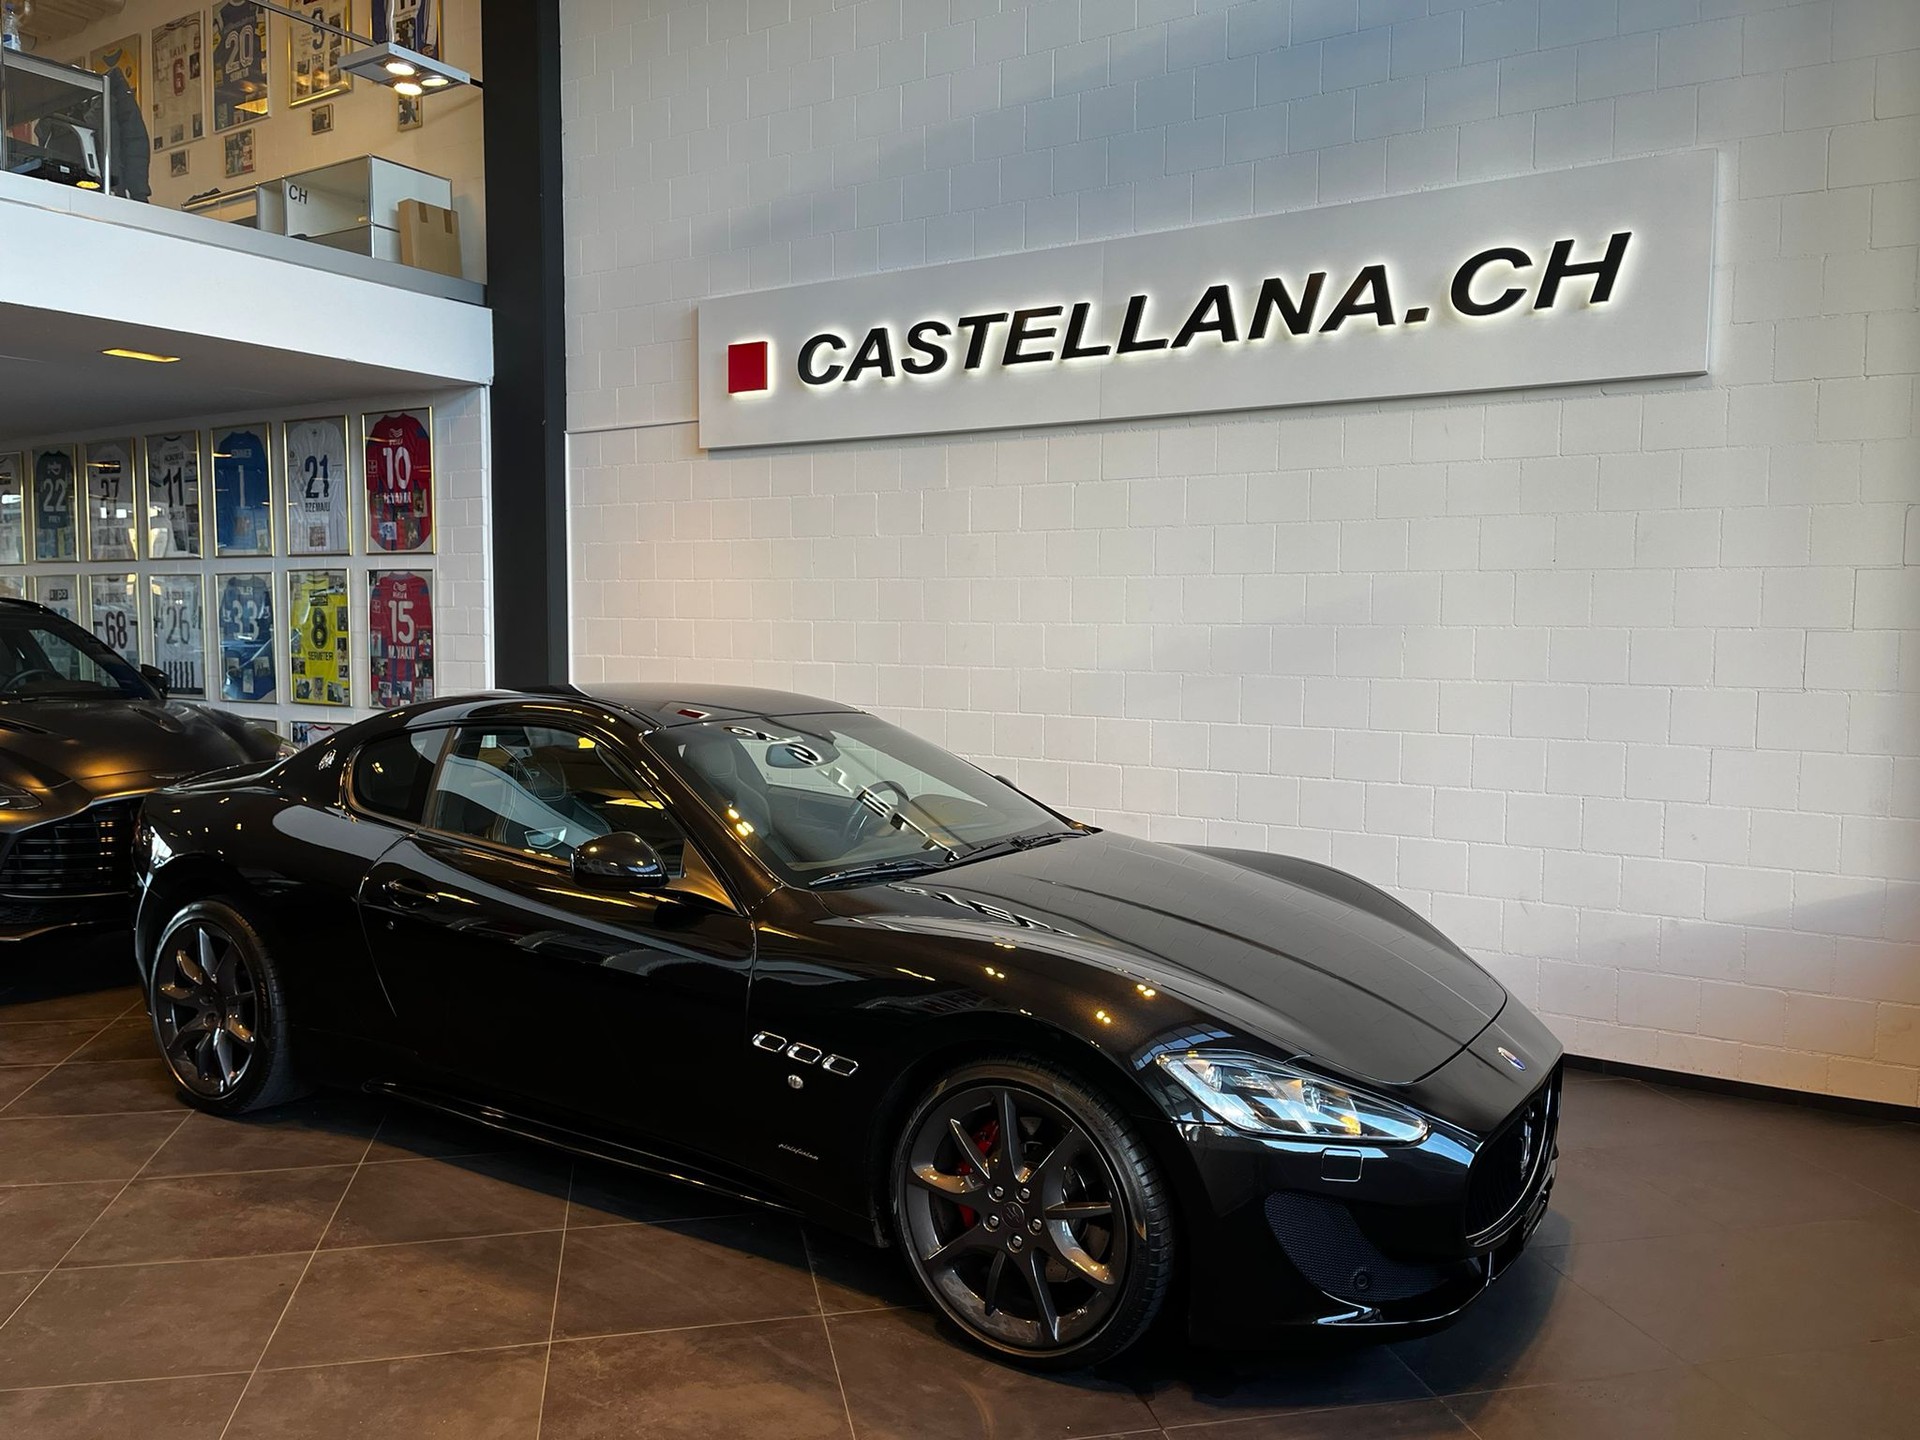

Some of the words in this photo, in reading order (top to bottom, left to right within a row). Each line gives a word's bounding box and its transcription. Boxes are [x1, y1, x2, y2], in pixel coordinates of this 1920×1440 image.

[225, 24, 254, 74] 20
[173, 57, 185, 97] 6
[289, 184, 308, 205] CH
[797, 231, 1633, 385] CASTELLANA.CH
[163, 467, 184, 508] 11
[304, 454, 330, 499] 21
[382, 446, 411, 490] 10
[42, 478, 66, 512] 22
[105, 610, 128, 649] 68
[166, 606, 190, 645] 26
[232, 600, 260, 641] 33
[311, 607, 329, 649] 8
[388, 600, 415, 644] 15
